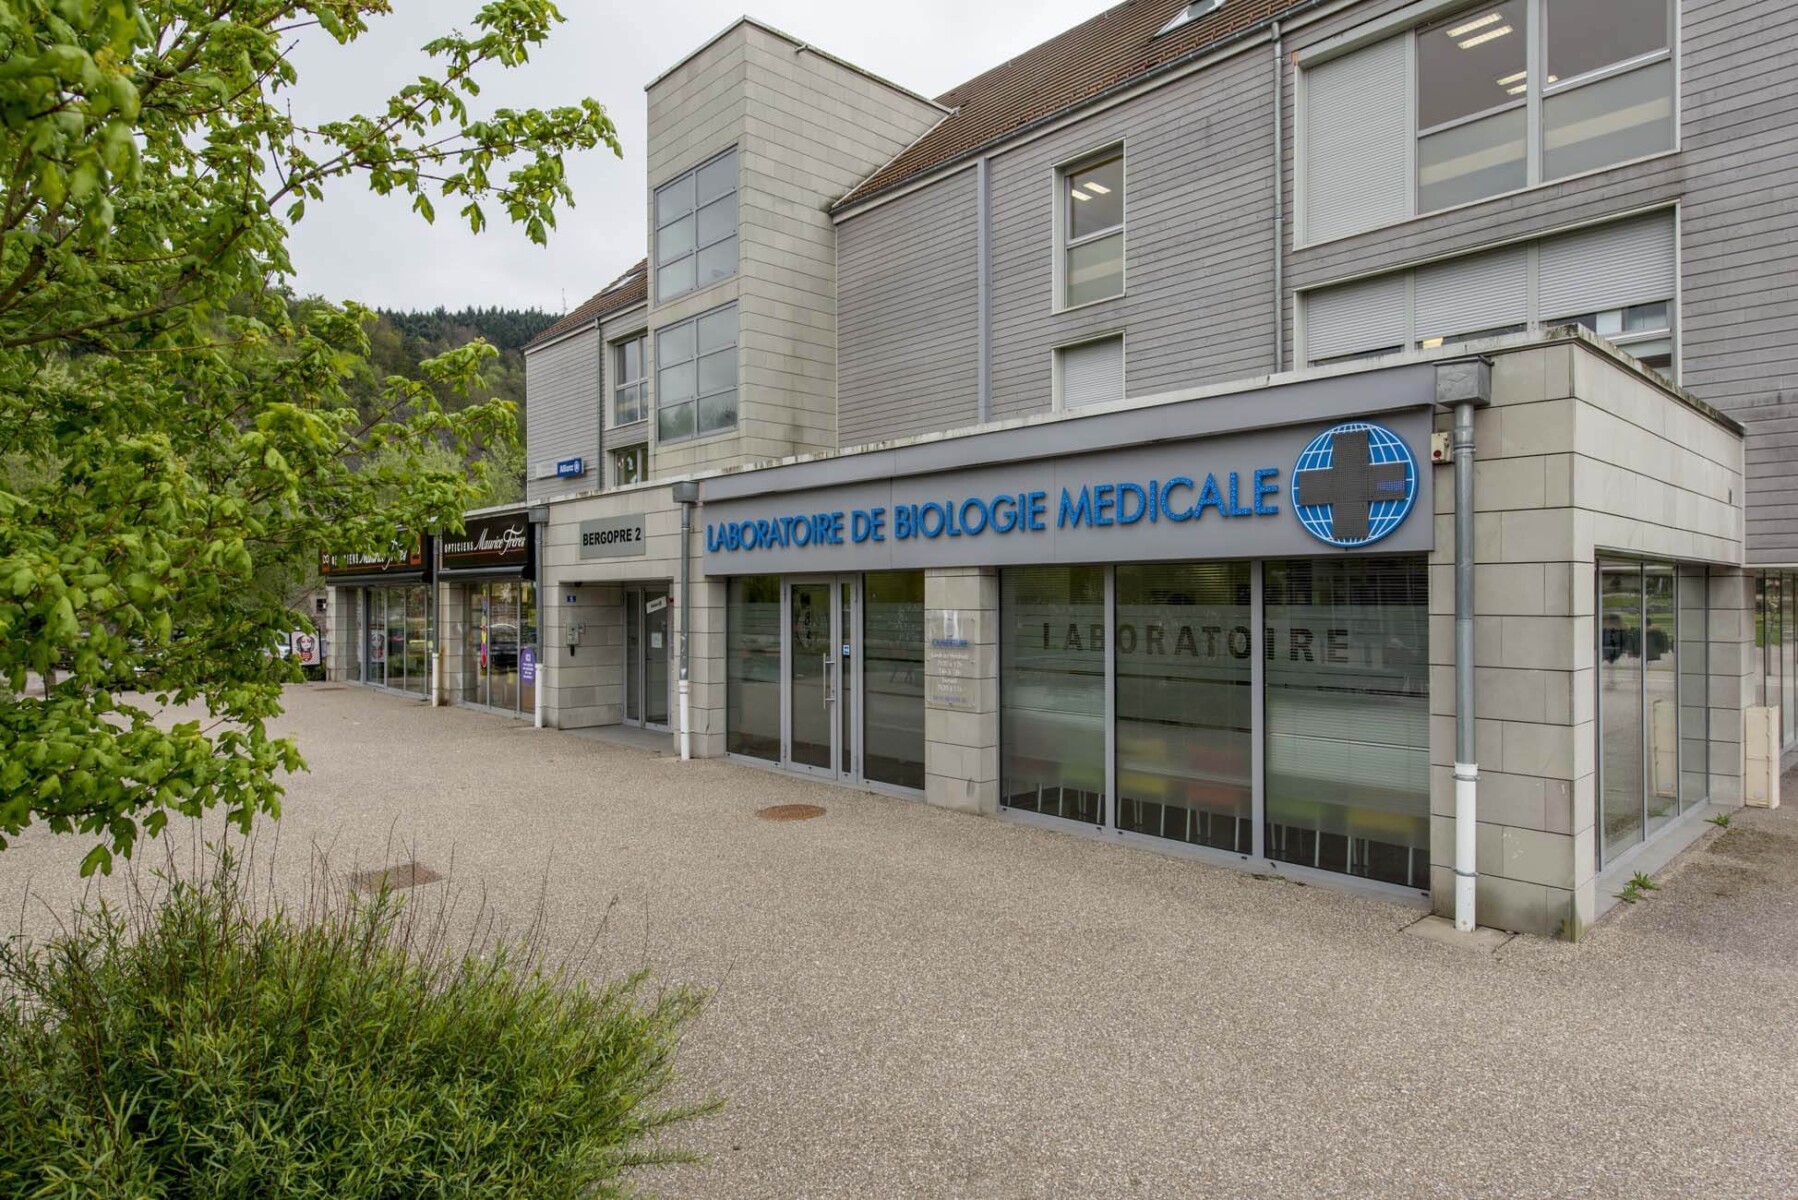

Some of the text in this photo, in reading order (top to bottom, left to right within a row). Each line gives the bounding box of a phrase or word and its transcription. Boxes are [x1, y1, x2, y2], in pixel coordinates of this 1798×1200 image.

[707, 467, 1280, 552] LABORATOIRE DE BIOLOGIE MEDICALE
[444, 541, 474, 554] OPTICIENS
[474, 528, 504, 551] Maurice
[582, 527, 642, 547] BERGOPRE 2
[1043, 622, 1349, 663] LABORATOIRE
